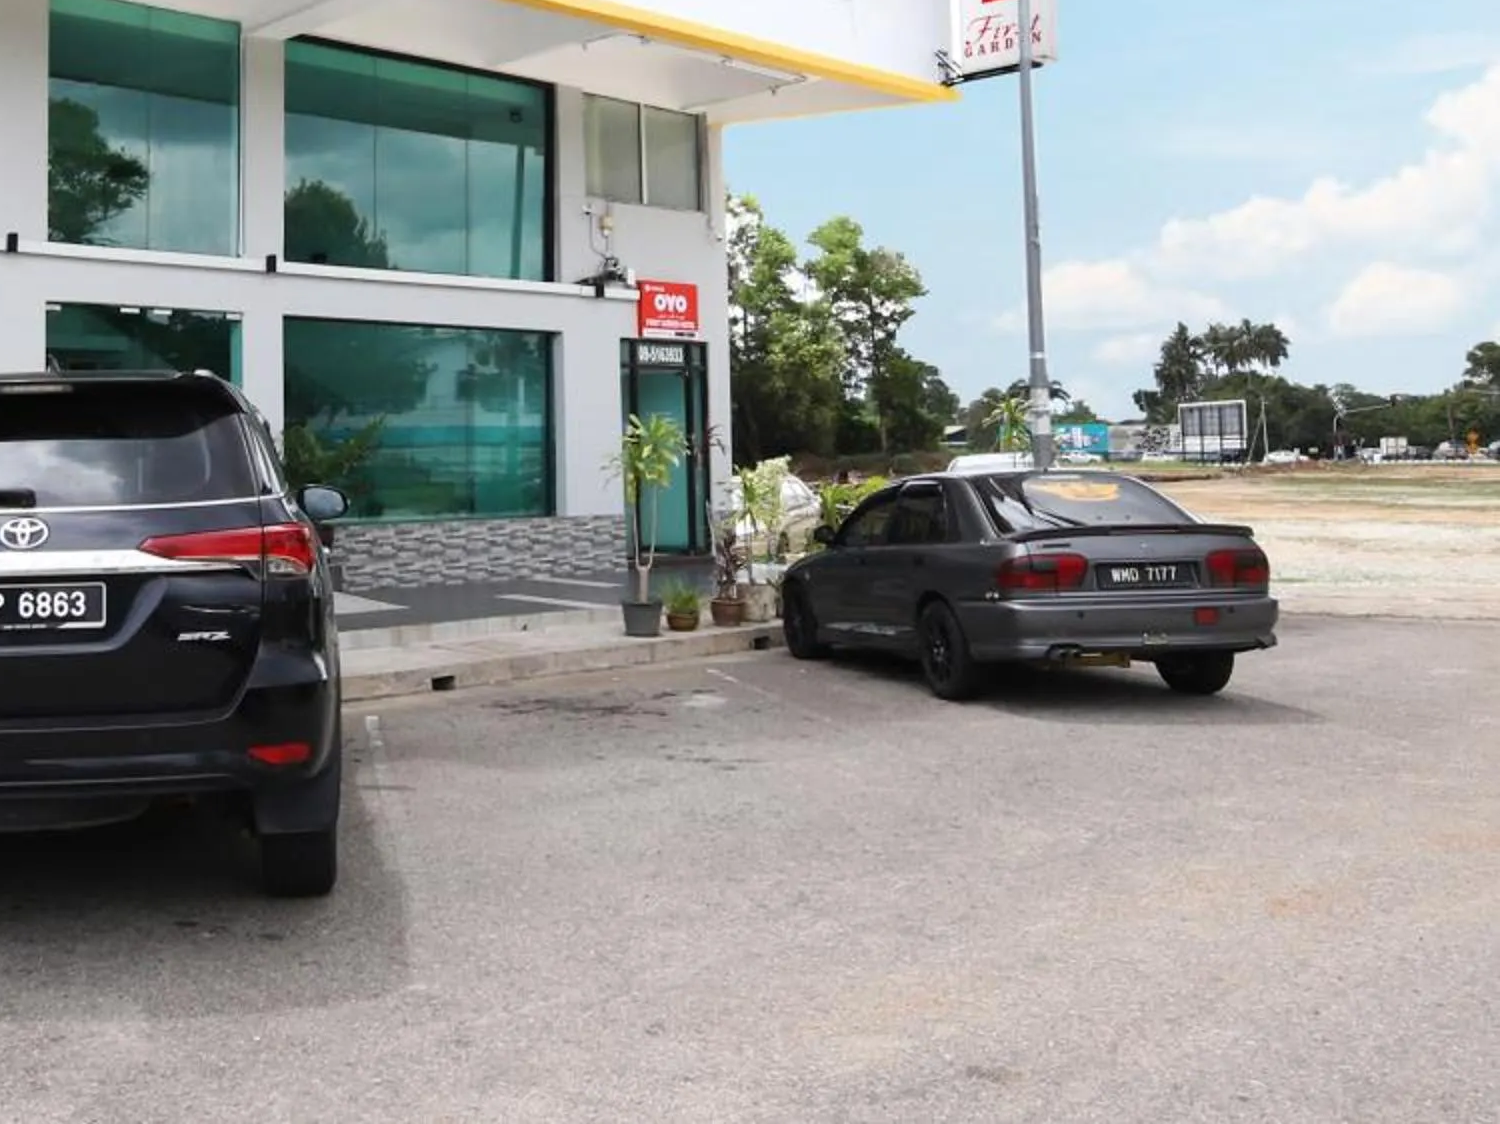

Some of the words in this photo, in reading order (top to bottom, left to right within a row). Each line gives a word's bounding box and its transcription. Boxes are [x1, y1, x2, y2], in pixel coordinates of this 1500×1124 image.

[963, 31, 1043, 58] GARDN
[654, 293, 688, 313] OYO
[18, 590, 86, 618] 6863
